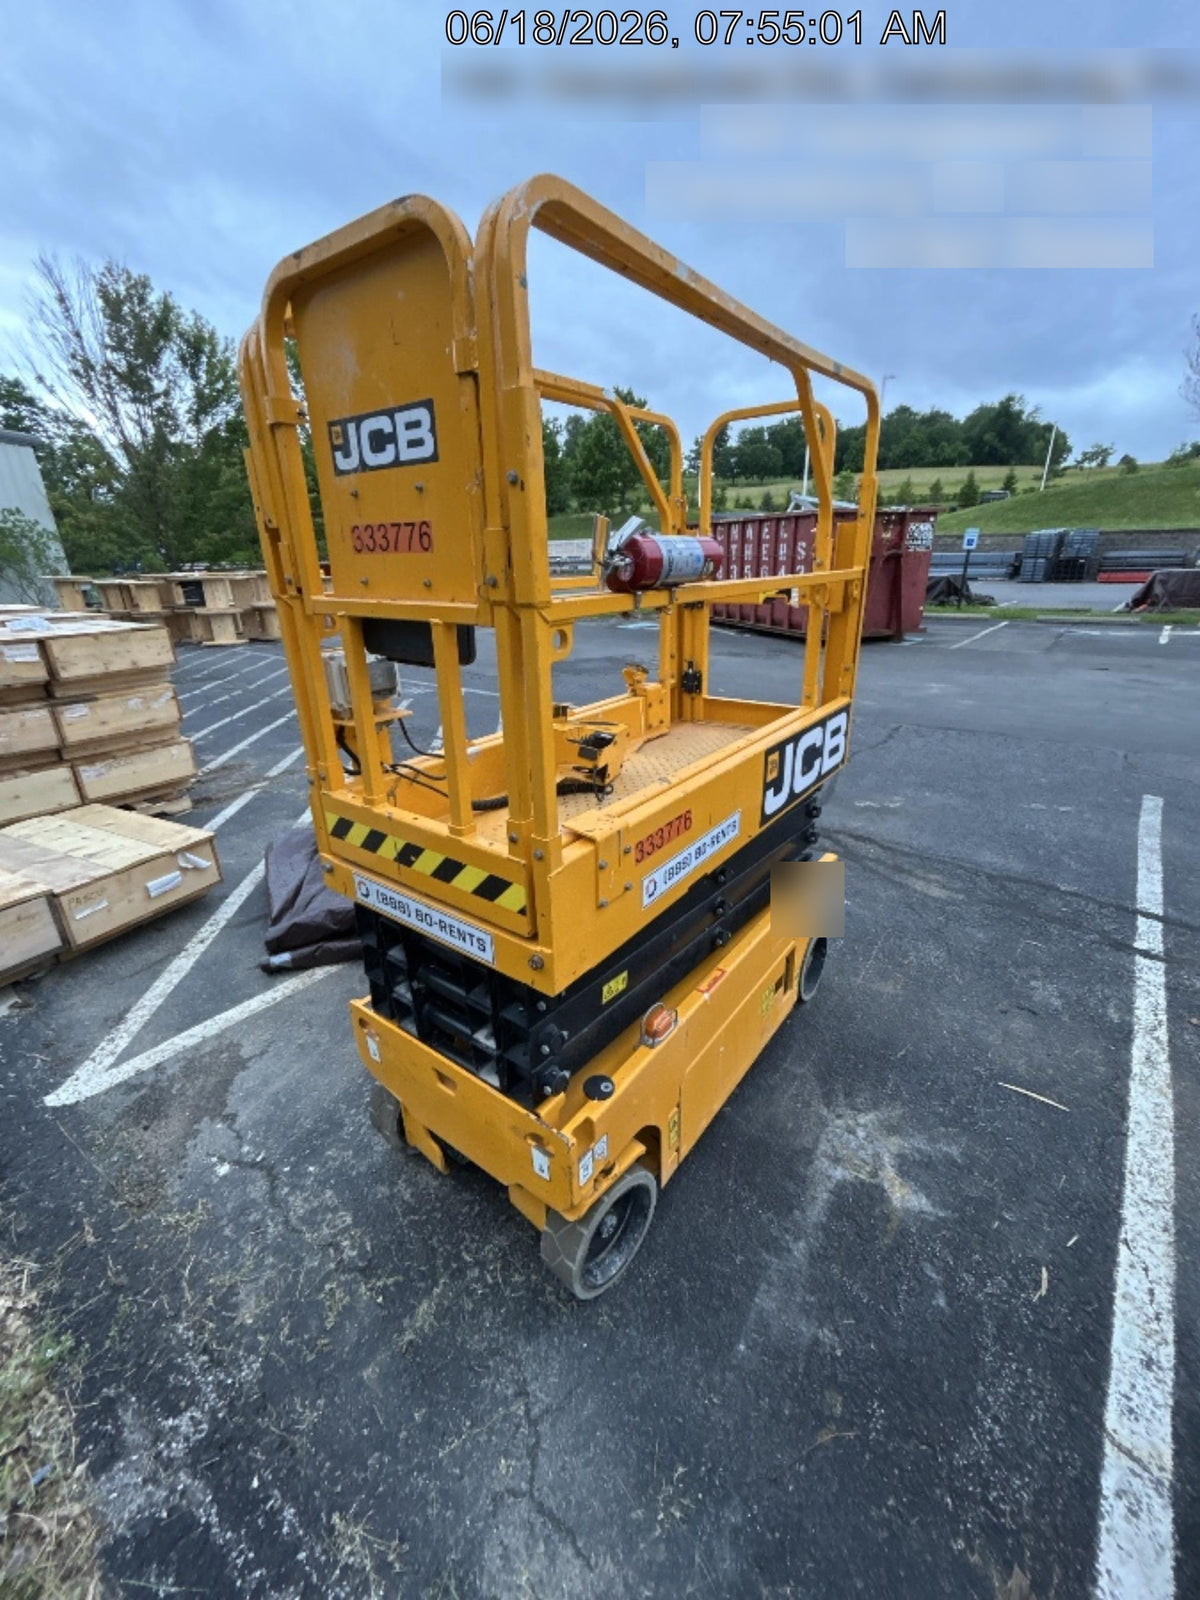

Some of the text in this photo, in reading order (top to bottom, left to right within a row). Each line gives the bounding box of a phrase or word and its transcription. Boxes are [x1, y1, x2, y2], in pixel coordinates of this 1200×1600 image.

[334, 406, 435, 470] JCB
[351, 520, 432, 553] 333776
[764, 711, 848, 815] JCB
[635, 809, 692, 863] 333776
[376, 889, 486, 953] (888) 80-RENTS
